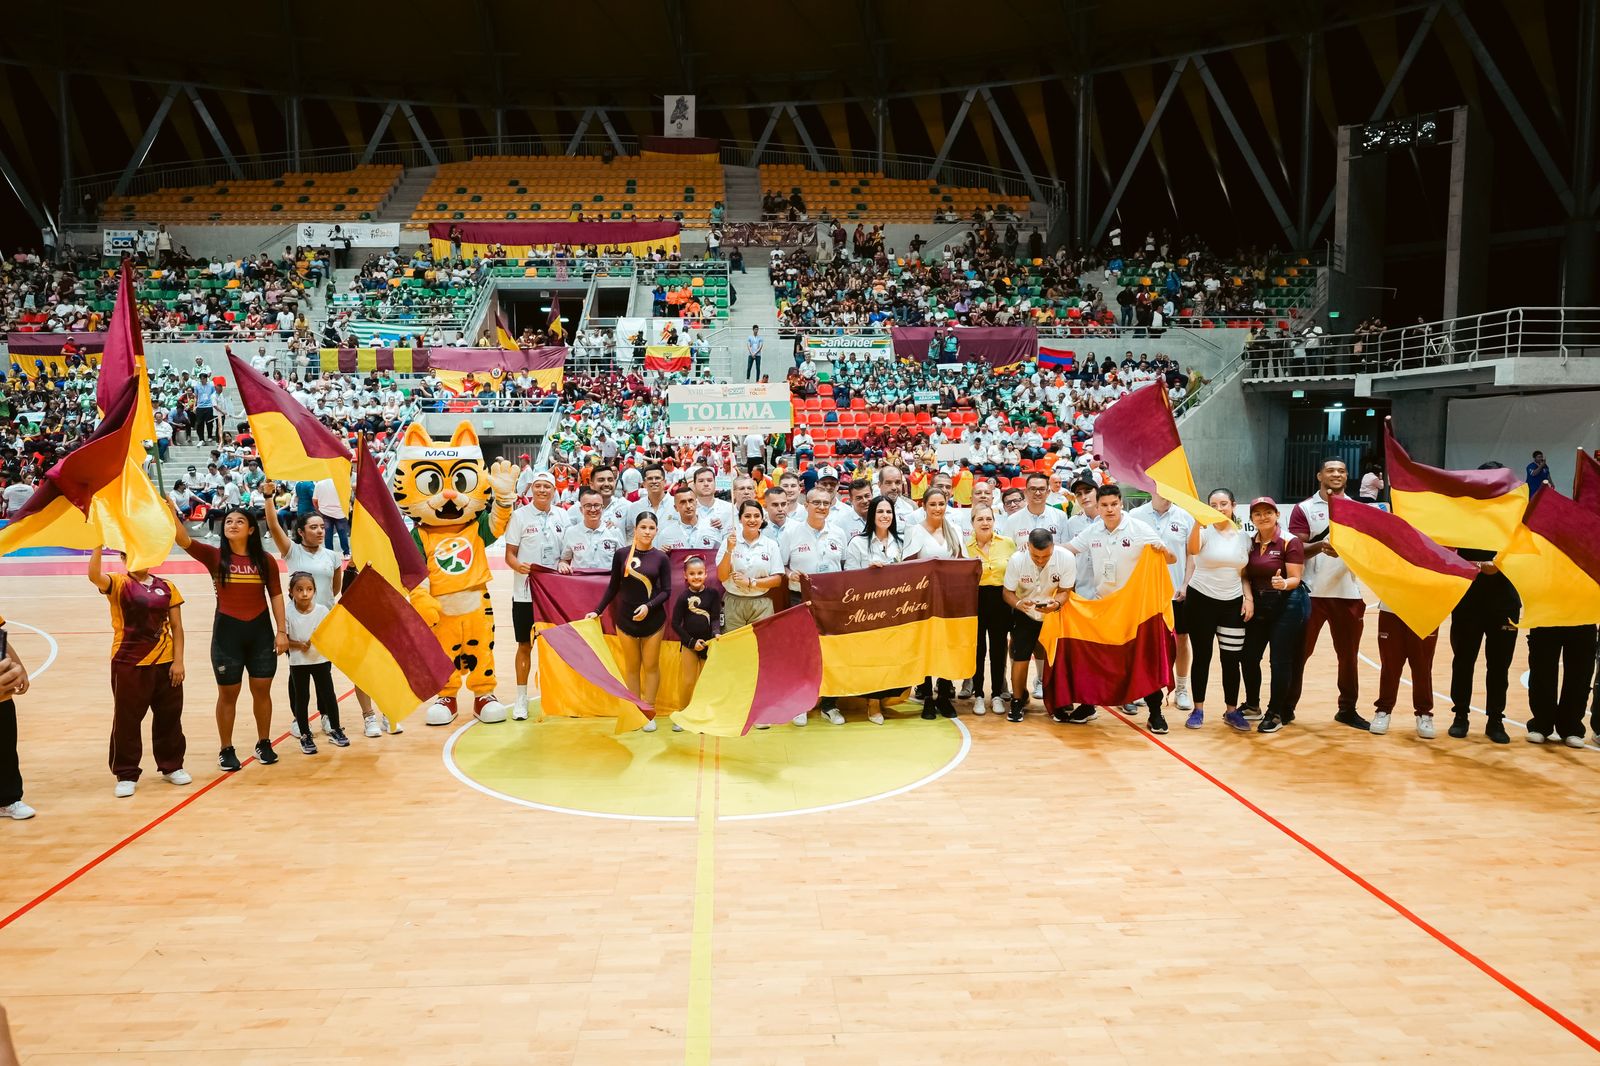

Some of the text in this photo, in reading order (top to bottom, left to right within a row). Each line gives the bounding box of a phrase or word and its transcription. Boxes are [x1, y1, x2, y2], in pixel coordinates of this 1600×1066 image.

[820, 338, 874, 348] Santander
[683, 402, 776, 421] TOLIMA
[229, 563, 259, 574] OLIM
[842, 575, 930, 604] En memoria de
[844, 600, 930, 626] Alvaro Ariza
